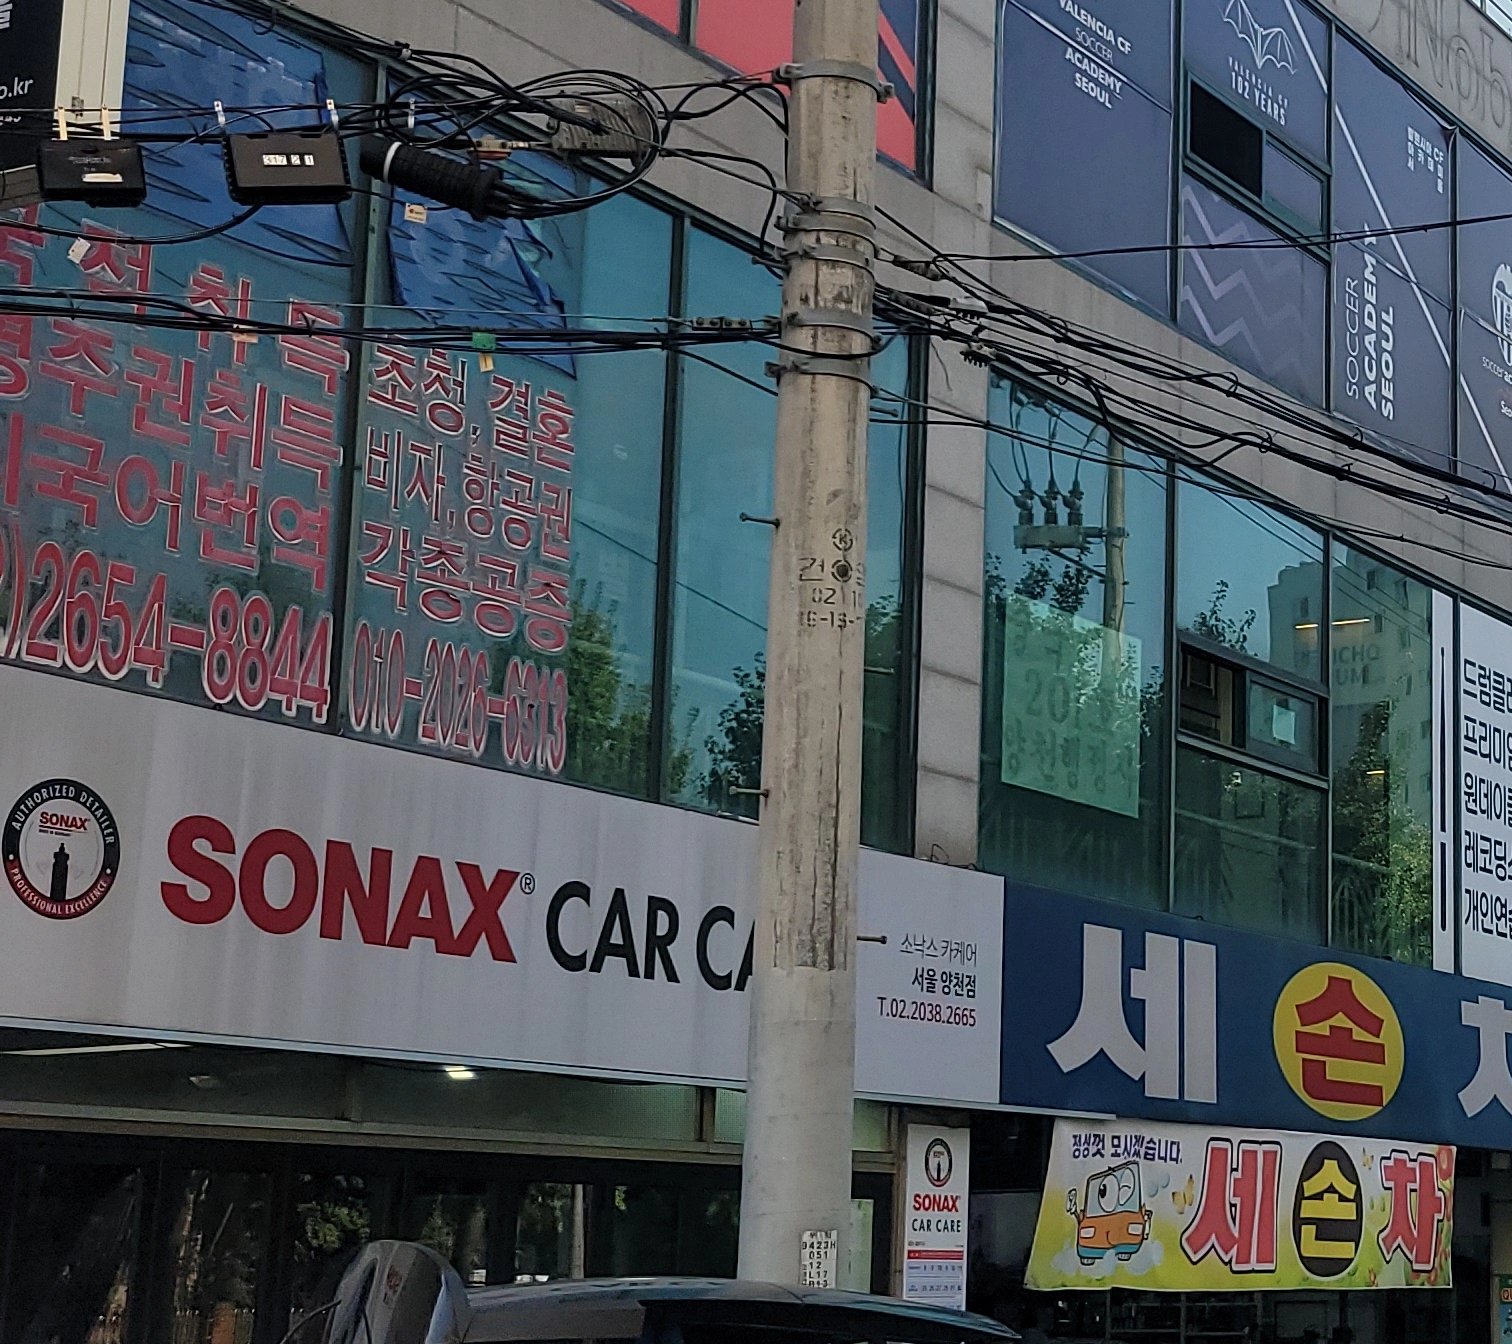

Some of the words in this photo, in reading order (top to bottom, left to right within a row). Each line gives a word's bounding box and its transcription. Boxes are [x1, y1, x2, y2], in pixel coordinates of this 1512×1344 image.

[1075, 27, 1114, 65] SOCCER
[1117, 36, 1132, 55] CF
[1064, 47, 1122, 94] ACADEMY
[1074, 72, 1112, 109] SEOUL
[1231, 71, 1250, 100] 102
[1254, 87, 1286, 126] YEARS
[1345, 277, 1359, 400] SOCCER
[1364, 222, 1377, 411] ACADEMY
[1381, 306, 1394, 421] SEOUL
[488, 372, 575, 474] 결혼
[463, 453, 574, 563] 항공권
[360, 519, 573, 653] 각종공증
[0, 518, 334, 724] )2654-8844
[11, 784, 76, 831] AUTHORIZED
[79, 791, 116, 844] DETAILER
[38, 811, 91, 831] SONAX
[10, 867, 62, 915] PROFESSIONAL
[65, 880, 108, 915] EXCELLENCE
[160, 814, 519, 964] SONAX
[545, 879, 680, 986] CAR
[900, 932, 939, 959] 소낙스
[941, 938, 977, 968] 카케어
[911, 966, 939, 994] 서울
[940, 970, 977, 999] 양천점
[876, 995, 977, 1027] T.02.2038.2665
[1072, 1133, 1106, 1159] 정성껏
[911, 1218, 932, 1233] CAR
[935, 1218, 962, 1234] CARE
[912, 1193, 960, 1213] SONAX
